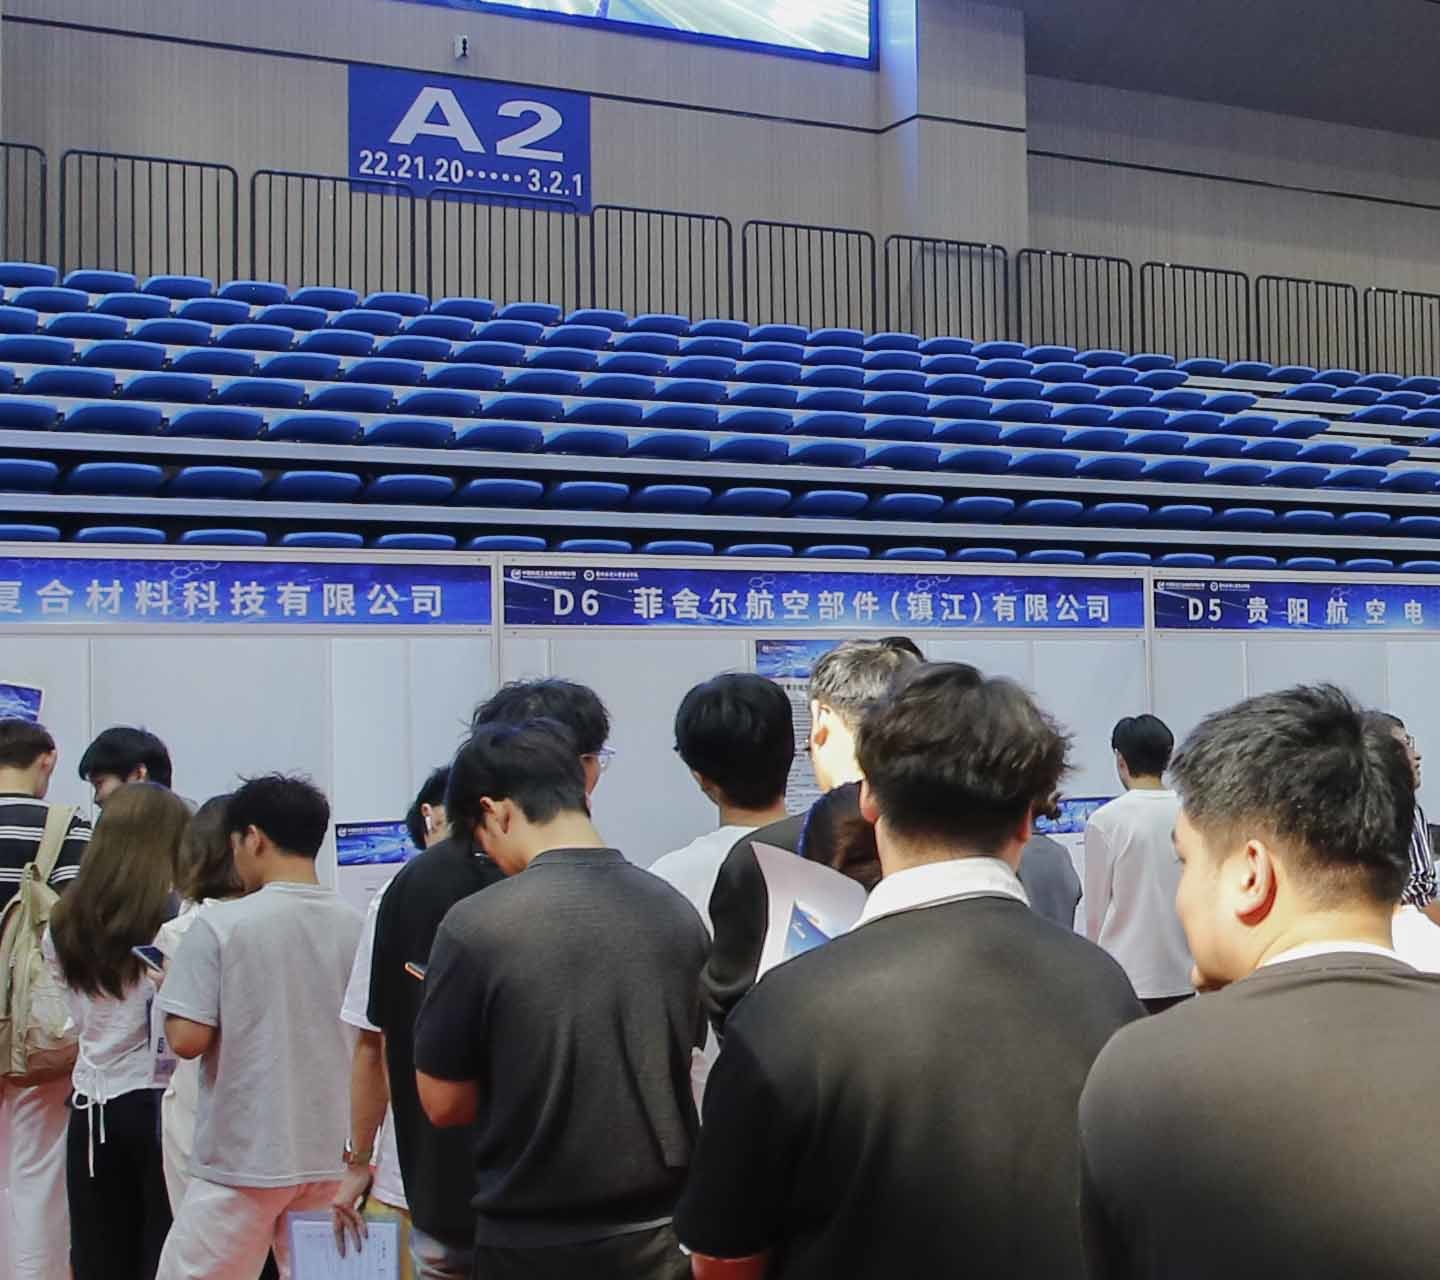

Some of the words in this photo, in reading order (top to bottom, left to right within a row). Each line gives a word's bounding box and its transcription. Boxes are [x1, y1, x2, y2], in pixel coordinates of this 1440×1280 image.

[388, 86, 564, 162] A2
[553, 588, 600, 616] D6
[1188, 598, 1222, 621] D5
